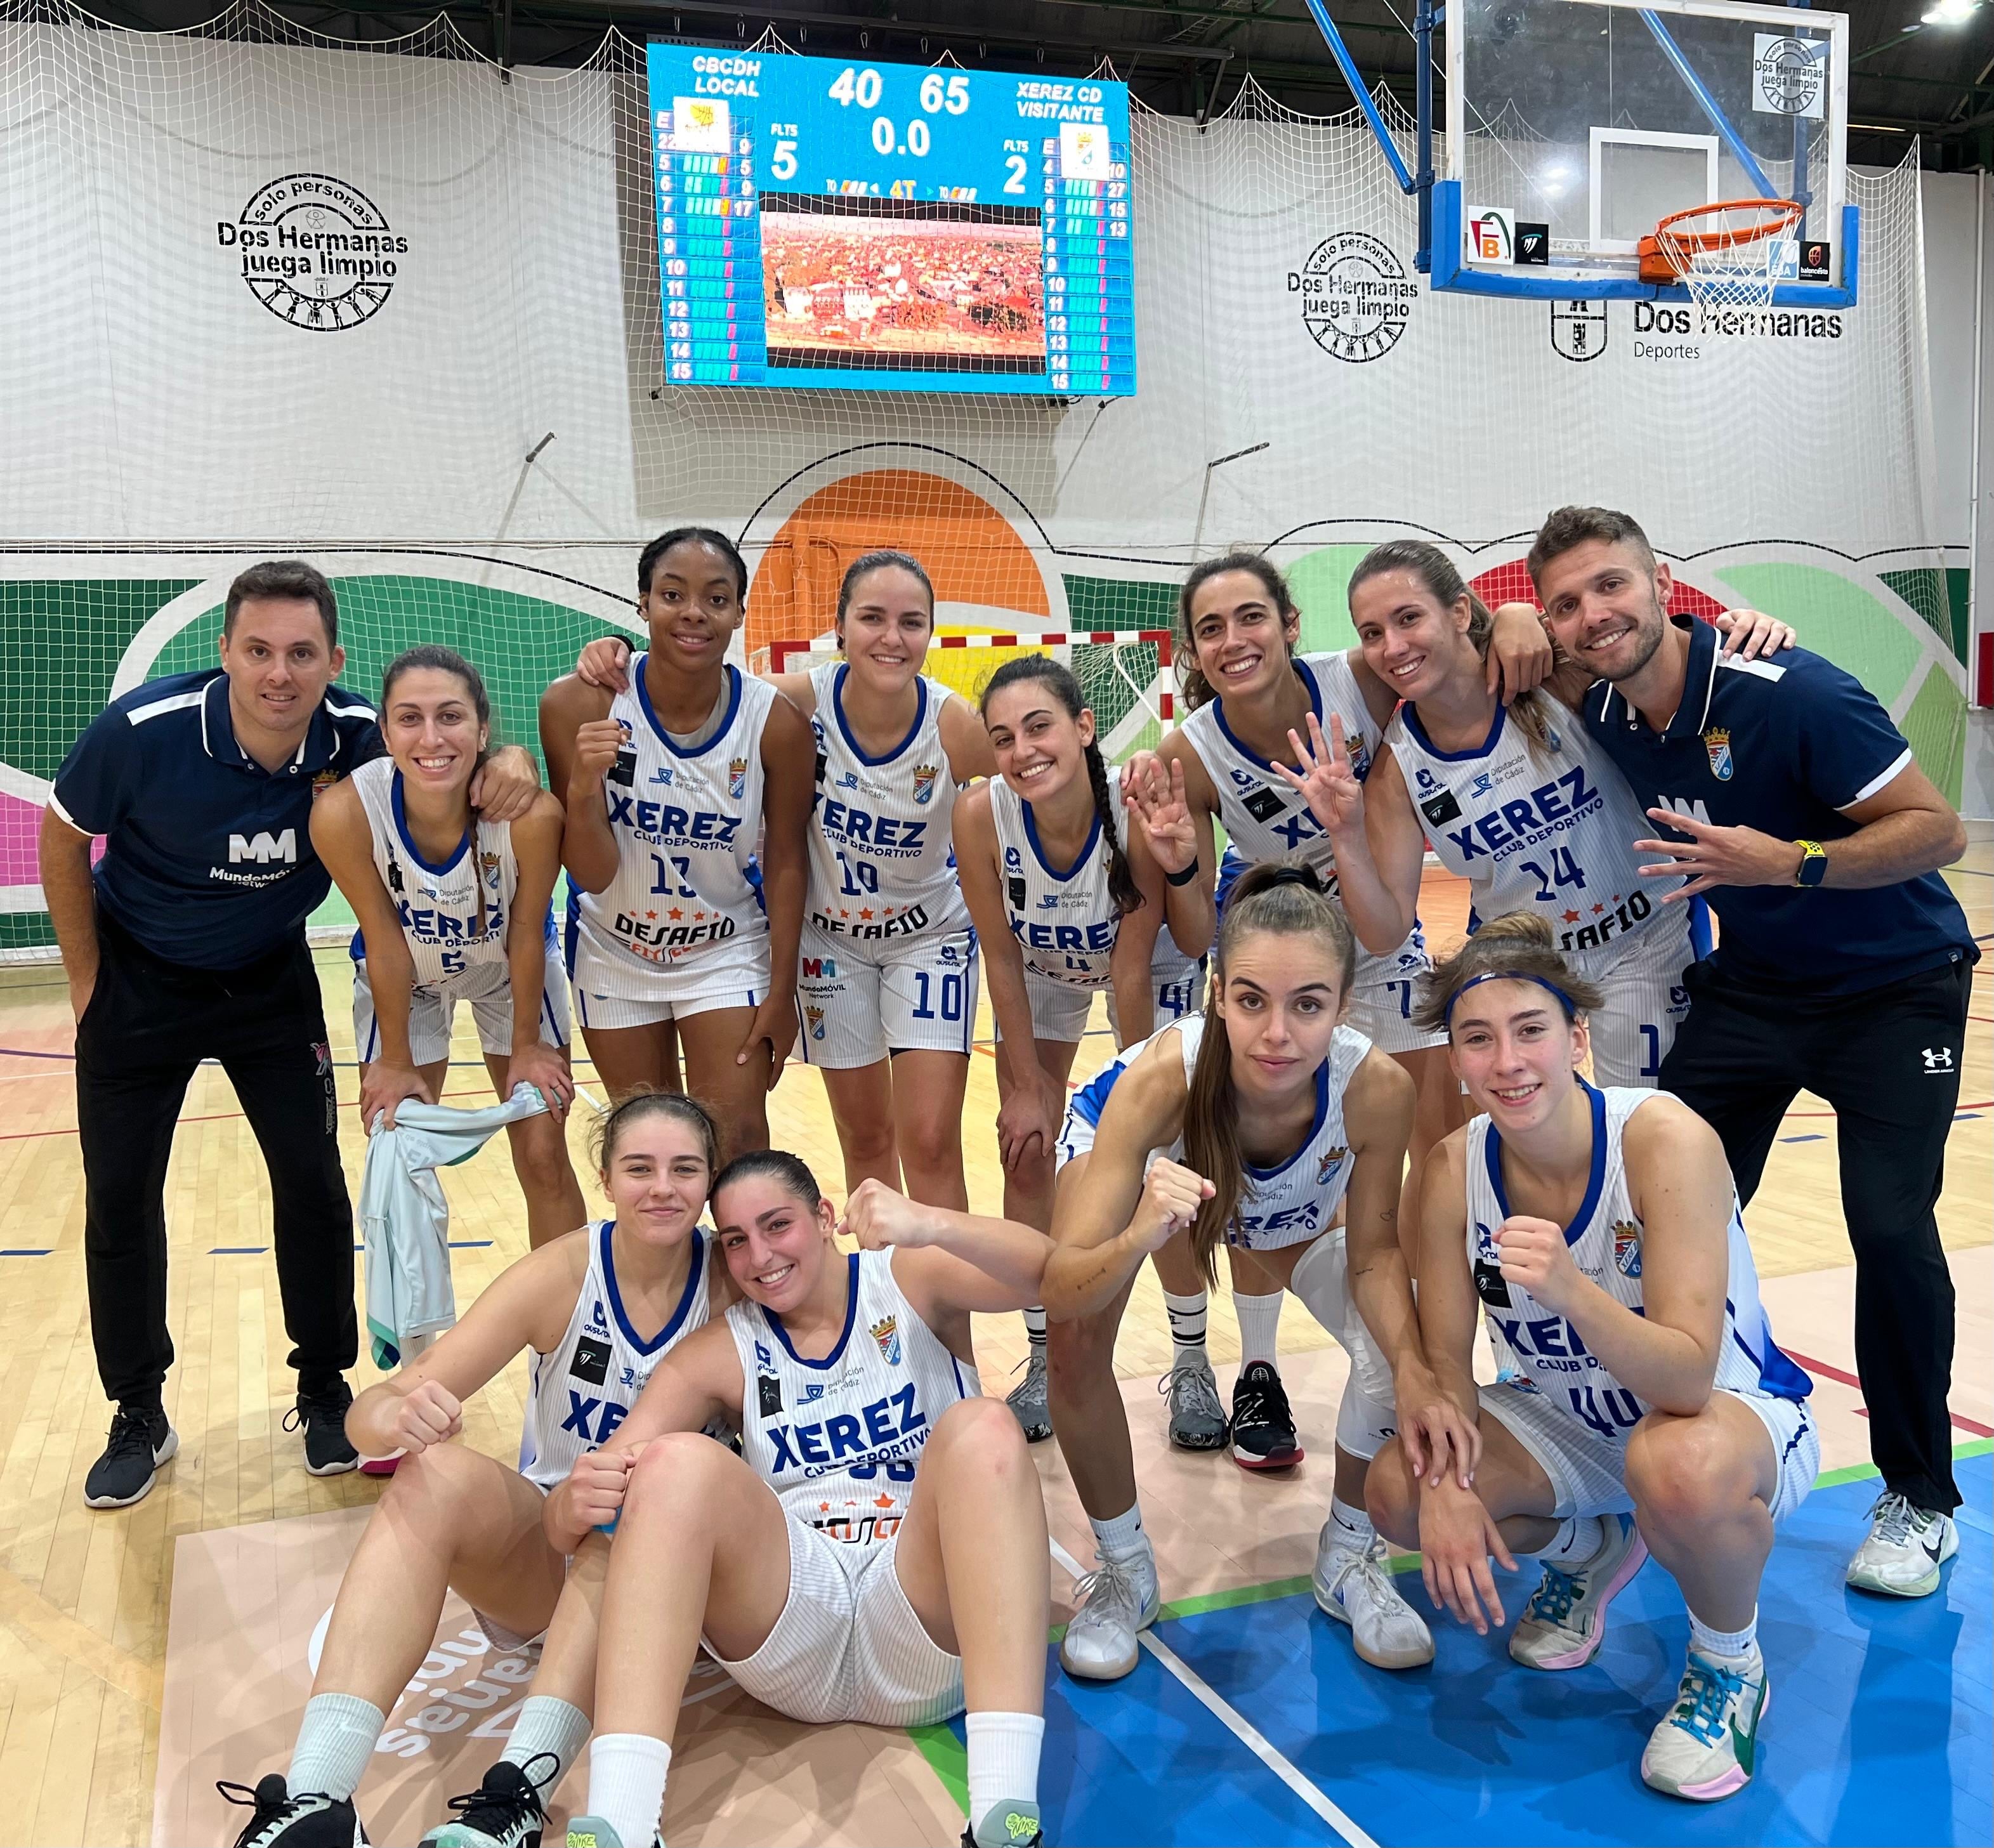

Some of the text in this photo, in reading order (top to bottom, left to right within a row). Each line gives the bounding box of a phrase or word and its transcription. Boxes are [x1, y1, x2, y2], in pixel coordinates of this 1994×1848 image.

[1755, 60, 1823, 78] Dos Hermanas
[695, 77, 759, 96] LOCAL
[1761, 71, 1818, 90] juega limpio
[828, 67, 969, 115] 40 65
[1016, 82, 1102, 103] XEREZ CD
[1017, 101, 1104, 122] VISITANTE
[739, 138, 749, 154] 9
[872, 116, 930, 157] 0.0
[659, 154, 751, 175] 5 5
[771, 140, 797, 180] 5
[1043, 159, 1125, 179] 4 10
[1003, 154, 1027, 194] 2
[660, 175, 752, 196] 6 9
[889, 180, 916, 200] 4T
[1044, 178, 1125, 198] 5 27
[255, 181, 372, 225] solo personas
[662, 196, 752, 216] 7 17
[1045, 198, 1125, 217] 6 15
[662, 217, 674, 233] 8
[1046, 217, 1127, 237] 7 13
[217, 221, 409, 254] Dos Hermanas
[664, 239, 675, 254] 9
[1046, 237, 1056, 253] 8
[240, 246, 397, 281] juega limpio
[1047, 257, 1056, 272] 9
[1313, 238, 1395, 274] solo personas
[666, 259, 685, 275] 10
[667, 280, 685, 296] 11
[1048, 277, 1065, 292] 10
[1288, 272, 1418, 298] Dos Hermanas
[668, 301, 688, 317] 12
[1048, 296, 1063, 311] 11
[1301, 292, 1409, 321] juega limpio
[669, 322, 689, 337] 13
[1049, 315, 1066, 331] 12
[1634, 301, 1842, 338] Dos Hermanas
[671, 343, 690, 358] 14
[1049, 335, 1067, 350] 13
[1634, 341, 1700, 362] Deportes
[672, 364, 691, 379] 15
[1050, 354, 1067, 370] 14
[1051, 373, 1068, 390] 15
[1491, 754, 1526, 777] Diputación
[1495, 766, 1525, 785] de Cádiz
[676, 771, 709, 785] Diputación
[860, 778, 893, 793] Diputación
[685, 783, 703, 794] Cádiz
[869, 790, 886, 800] Cádiz
[609, 790, 742, 843] XEREZ
[1446, 765, 1598, 861] XEREZ
[1493, 797, 1604, 862] CLUB DEPORTIVO
[228, 829, 296, 863] MM
[634, 830, 734, 853] CLUB DEPORTIVO
[822, 829, 922, 858] CLUB DEPORTIVO
[209, 867, 296, 882] MundoMÓ
[836, 851, 879, 896] 10
[439, 884, 475, 896] Diputación
[452, 895, 469, 905] Cádiz
[615, 913, 735, 945] DESAFIO
[1559, 889, 1651, 952] SAFIO
[445, 928, 501, 947] DEPORTI
[442, 950, 466, 973] 5
[803, 958, 836, 978] MM
[799, 983, 846, 992] MundoMÓVIL
[912, 973, 961, 1021] 10
[1640, 1025, 1660, 1076] 1
[584, 1325, 610, 1338] austra
[1537, 1358, 1582, 1372] CLUB
[766, 1382, 926, 1474] XEREZ
